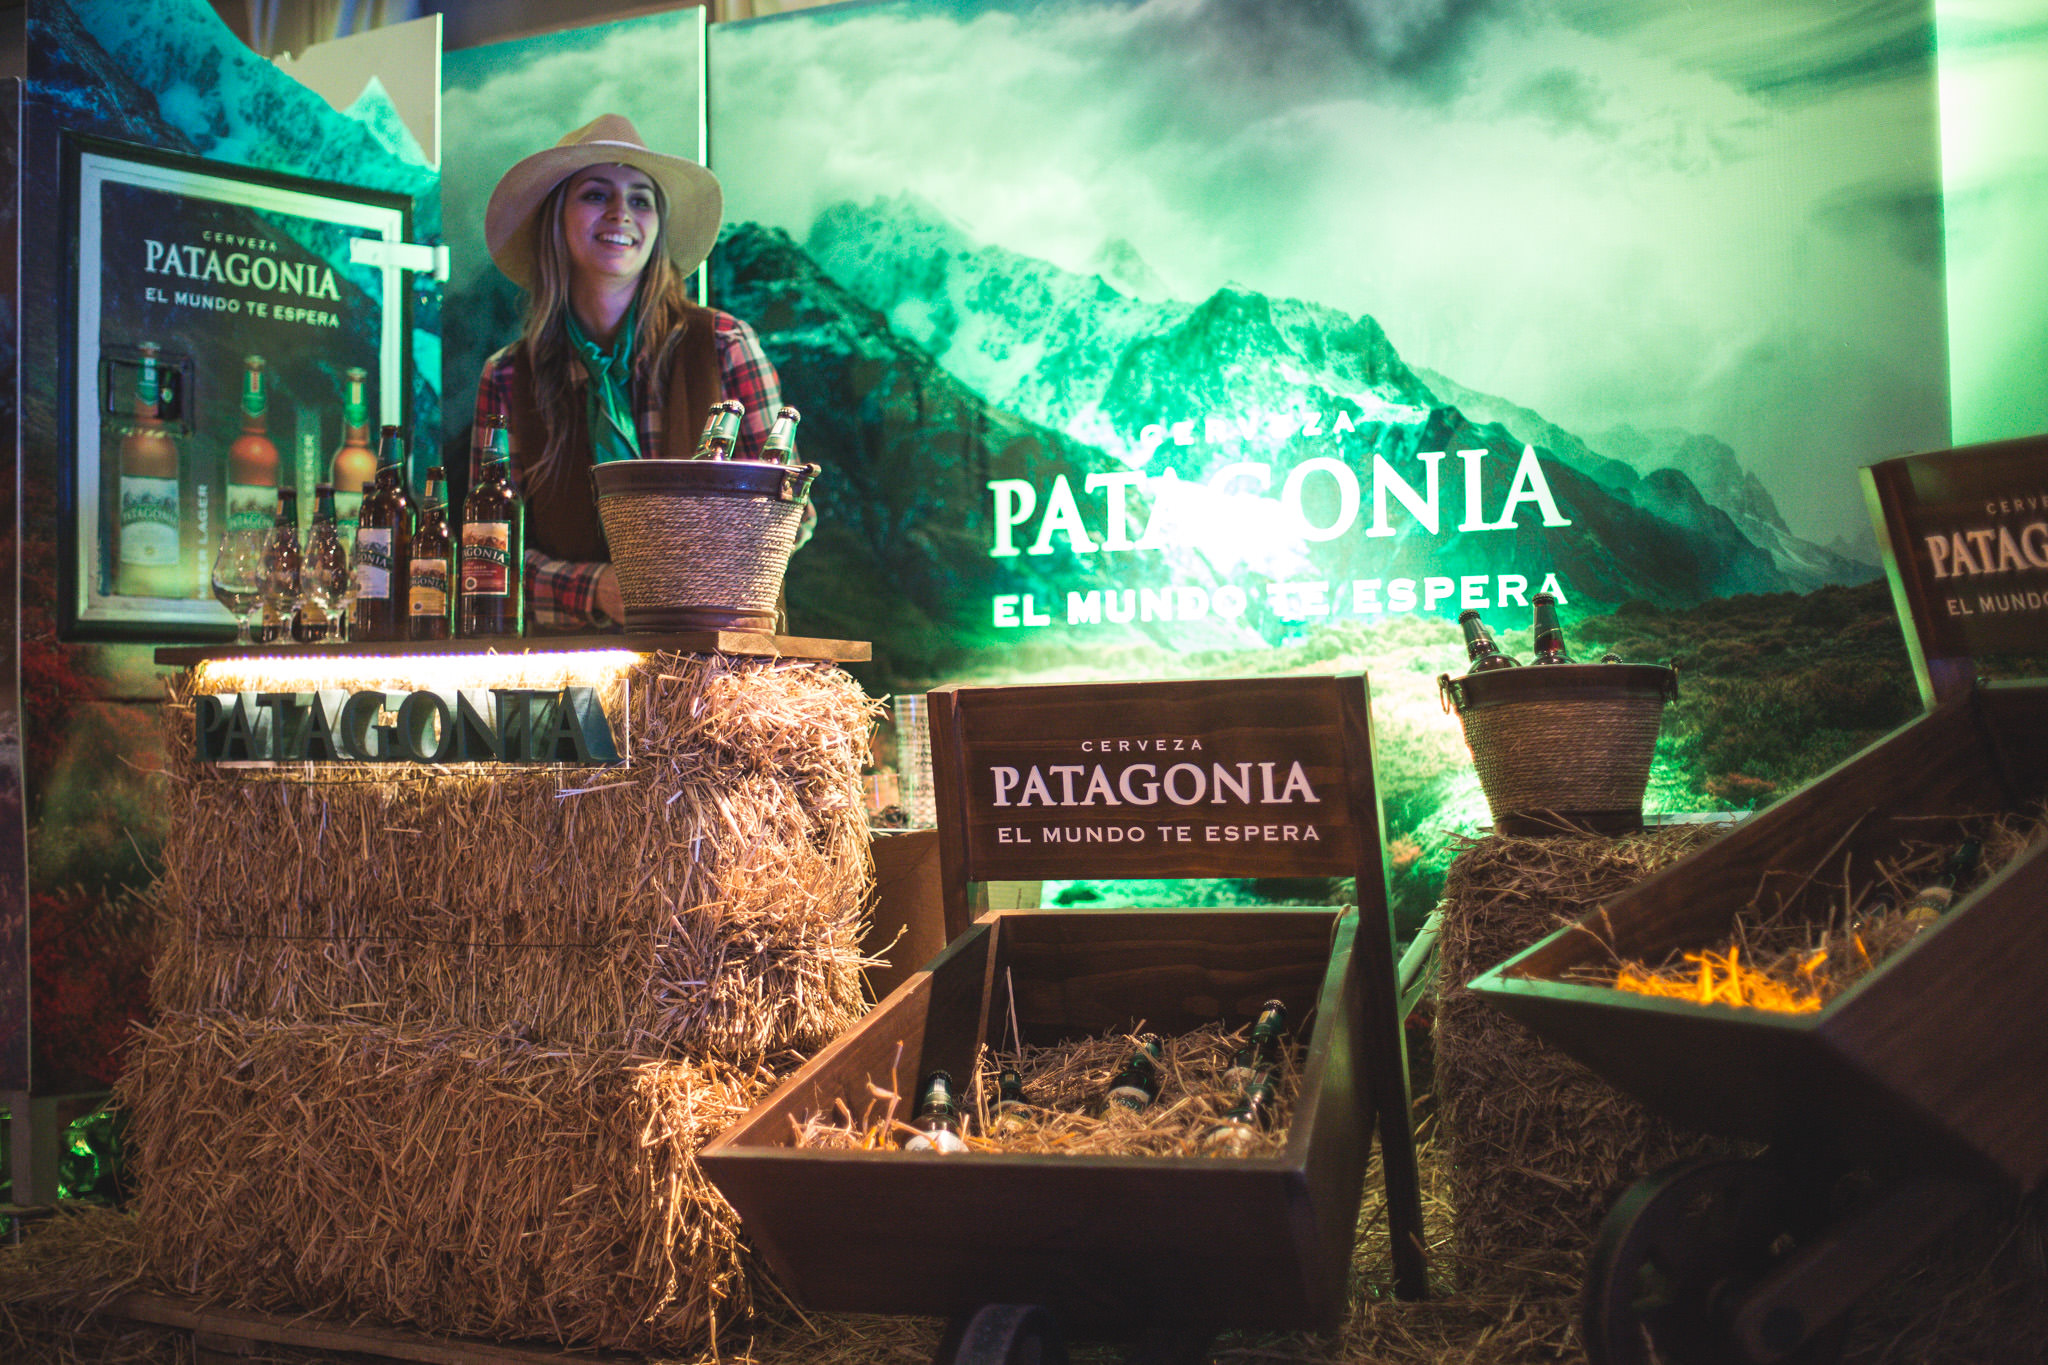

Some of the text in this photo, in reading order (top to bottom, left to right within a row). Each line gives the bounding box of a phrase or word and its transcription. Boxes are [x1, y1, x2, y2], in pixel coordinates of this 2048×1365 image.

[202, 230, 278, 252] CERVEZA
[144, 239, 342, 302] PATAGONIA
[145, 287, 341, 328] EL MUNDO TE ESPERA
[197, 484, 210, 545] LAGER
[992, 573, 1569, 628] EL MUNDO TE ESPERA
[1947, 597, 1974, 616] EL
[193, 688, 596, 763] PATAGONIA
[1081, 739, 1203, 752] CERVEZA
[990, 760, 1321, 806] PATAGONIA
[998, 825, 1321, 843] EL MUNDO TE ESPERA
